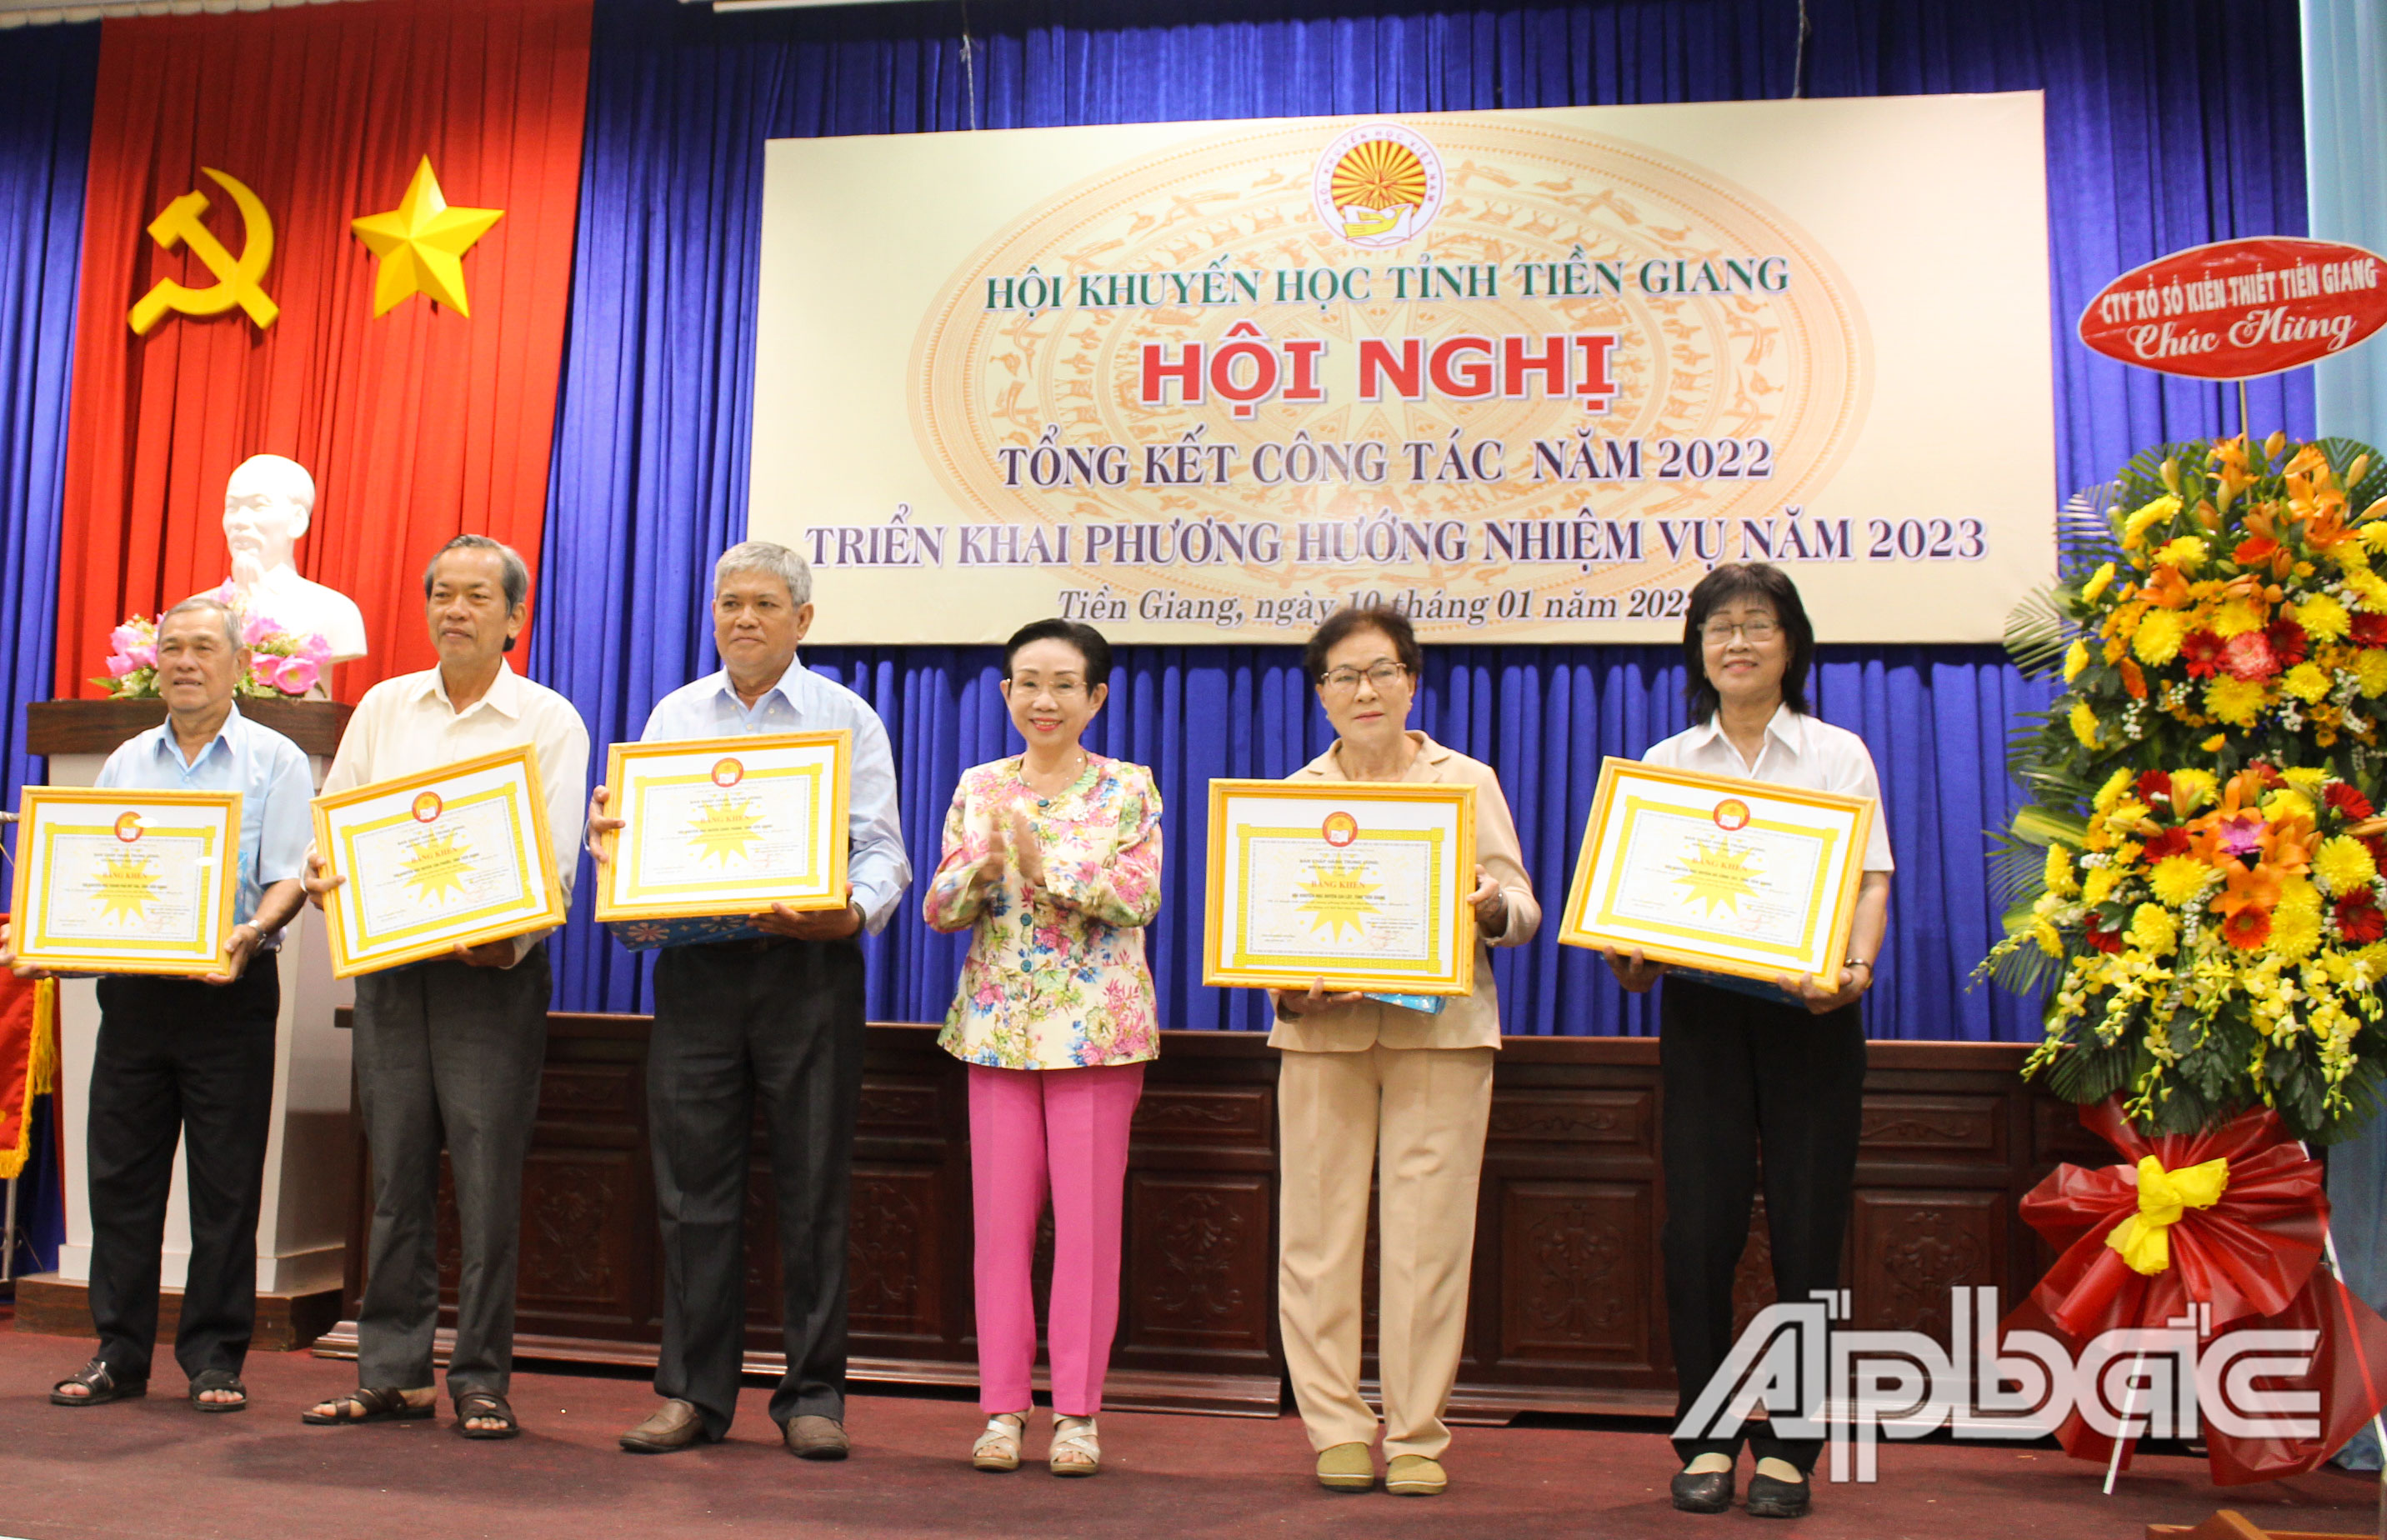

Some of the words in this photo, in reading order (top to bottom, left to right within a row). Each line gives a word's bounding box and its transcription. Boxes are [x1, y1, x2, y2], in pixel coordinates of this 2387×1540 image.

[985, 266, 1063, 317] HỘI
[1078, 253, 1260, 308] KHUYẾN
[1275, 267, 1371, 312] HỌC
[1388, 252, 1498, 300] TỈNH
[1514, 245, 1622, 297] TIỀN
[1639, 256, 1789, 294] GIANG
[2102, 292, 2132, 324] CTY
[2322, 257, 2378, 295] GIANG
[2127, 321, 2219, 360] Chúc
[2229, 306, 2358, 352] Mừng
[1141, 320, 1327, 418] HỘI
[1359, 335, 1620, 412] NGHỊ
[999, 425, 1128, 488] TỔNG
[1143, 422, 1238, 484] KẾT
[1253, 430, 1387, 484] CÔNG
[1403, 429, 1504, 482] TÁC
[1534, 428, 1644, 481] NĂM
[1658, 438, 1773, 479] 2022
[805, 504, 947, 567] TRIỂN
[958, 523, 1069, 566] KHAI
[1084, 516, 1282, 564] PHƯƠNG
[1298, 507, 1467, 562] HƯỚNG
[1484, 506, 1643, 572] NHIỆM
[1658, 518, 1726, 570] VỤ
[1741, 506, 1852, 560] NĂM
[1869, 518, 1987, 560] 2023
[1058, 586, 1126, 619] Tiền
[1139, 588, 1243, 625] Giang,
[1254, 588, 1334, 625] ngày
[1349, 589, 1381, 611] 10
[1391, 587, 1489, 625] tháng
[1498, 588, 1532, 619] 01
[1542, 588, 1617, 618] năm
[1627, 588, 1692, 618] 202
